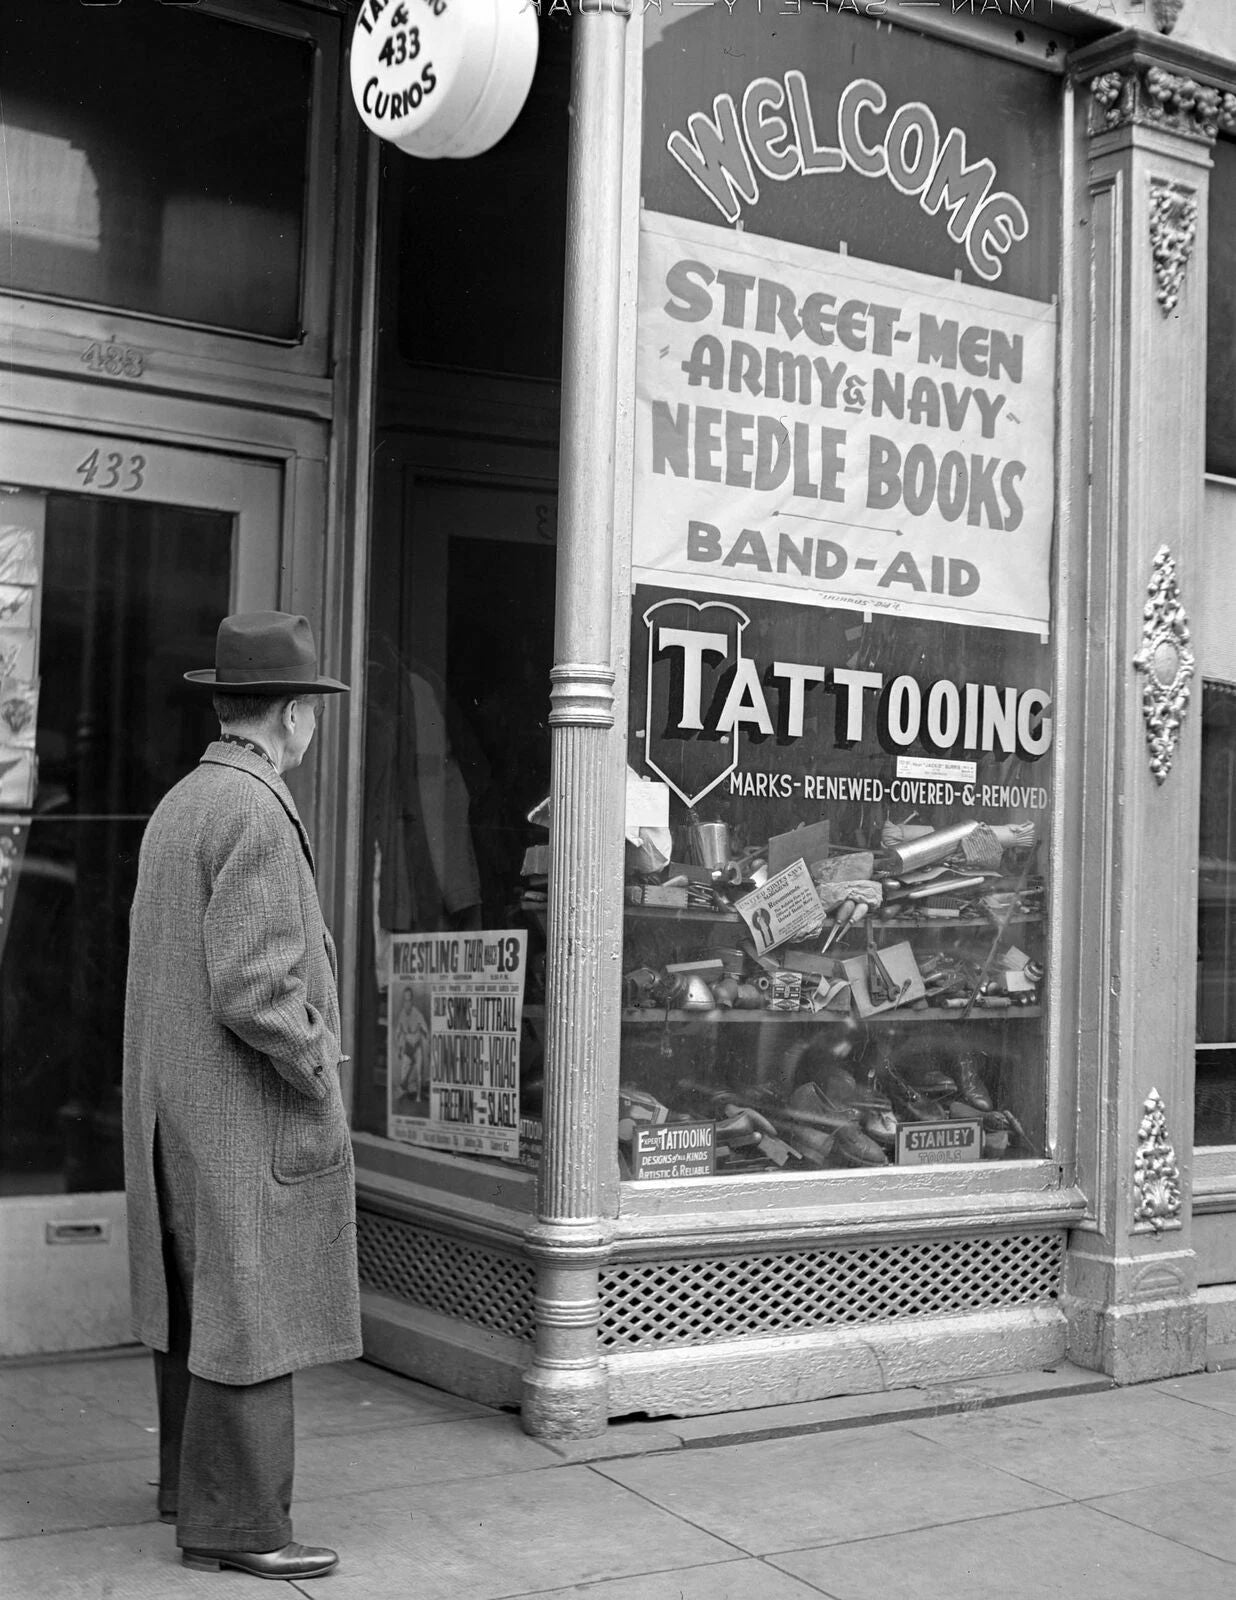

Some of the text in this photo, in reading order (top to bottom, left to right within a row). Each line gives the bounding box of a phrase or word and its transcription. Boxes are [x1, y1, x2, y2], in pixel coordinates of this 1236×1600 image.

[378, 26, 421, 67] 433
[363, 61, 437, 120] CURIOS
[667, 70, 1029, 281] WELCOME
[842, 374, 869, 415] &
[76, 448, 147, 491] 433
[651, 400, 1027, 532] NEEDLE BOOKS
[687, 520, 981, 598] BAND-AID
[658, 627, 1053, 757] TATTOOING
[393, 940, 459, 974] WRESTLING
[497, 937, 520, 972] 13
[642, 1154, 672, 1166] DESIGNS
[686, 1151, 708, 1162] KINDS
[658, 1128, 712, 1150] TATTOOING
[911, 1128, 969, 1149] STANLEY
[639, 1164, 711, 1179] ARTISTIC & RELIABLE
